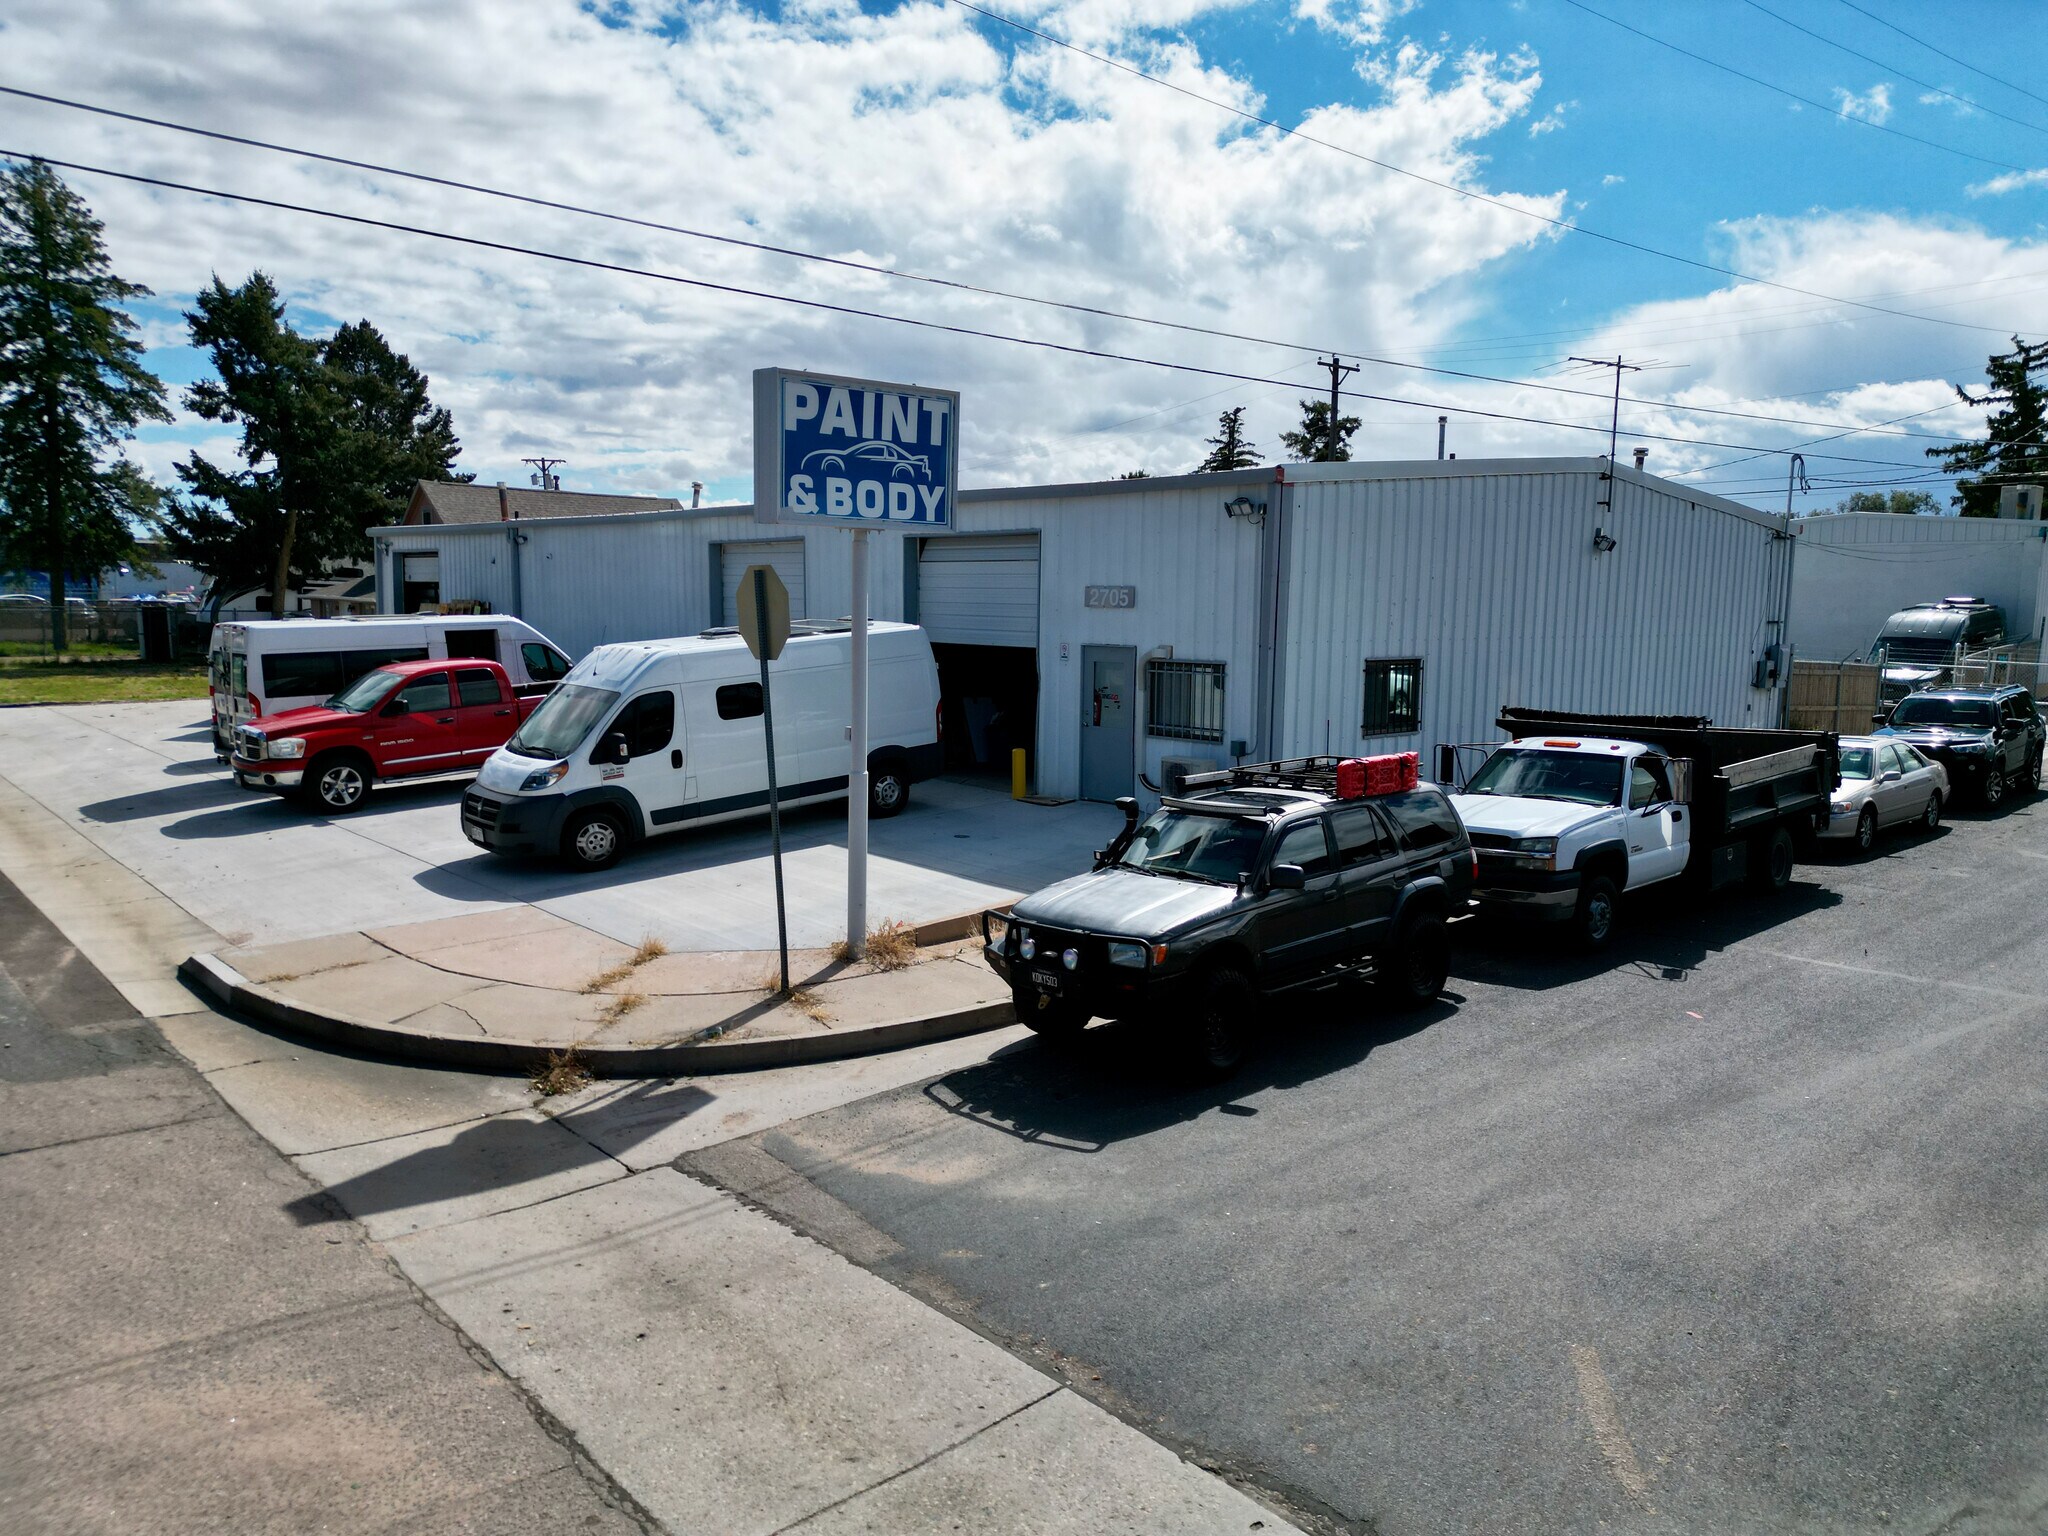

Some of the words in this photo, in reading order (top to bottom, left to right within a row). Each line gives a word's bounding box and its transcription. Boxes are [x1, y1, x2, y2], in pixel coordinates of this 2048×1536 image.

[785, 382, 949, 446] PAINT
[788, 474, 820, 514] &
[826, 477, 946, 521] BODY
[1089, 588, 1128, 607] 2705
